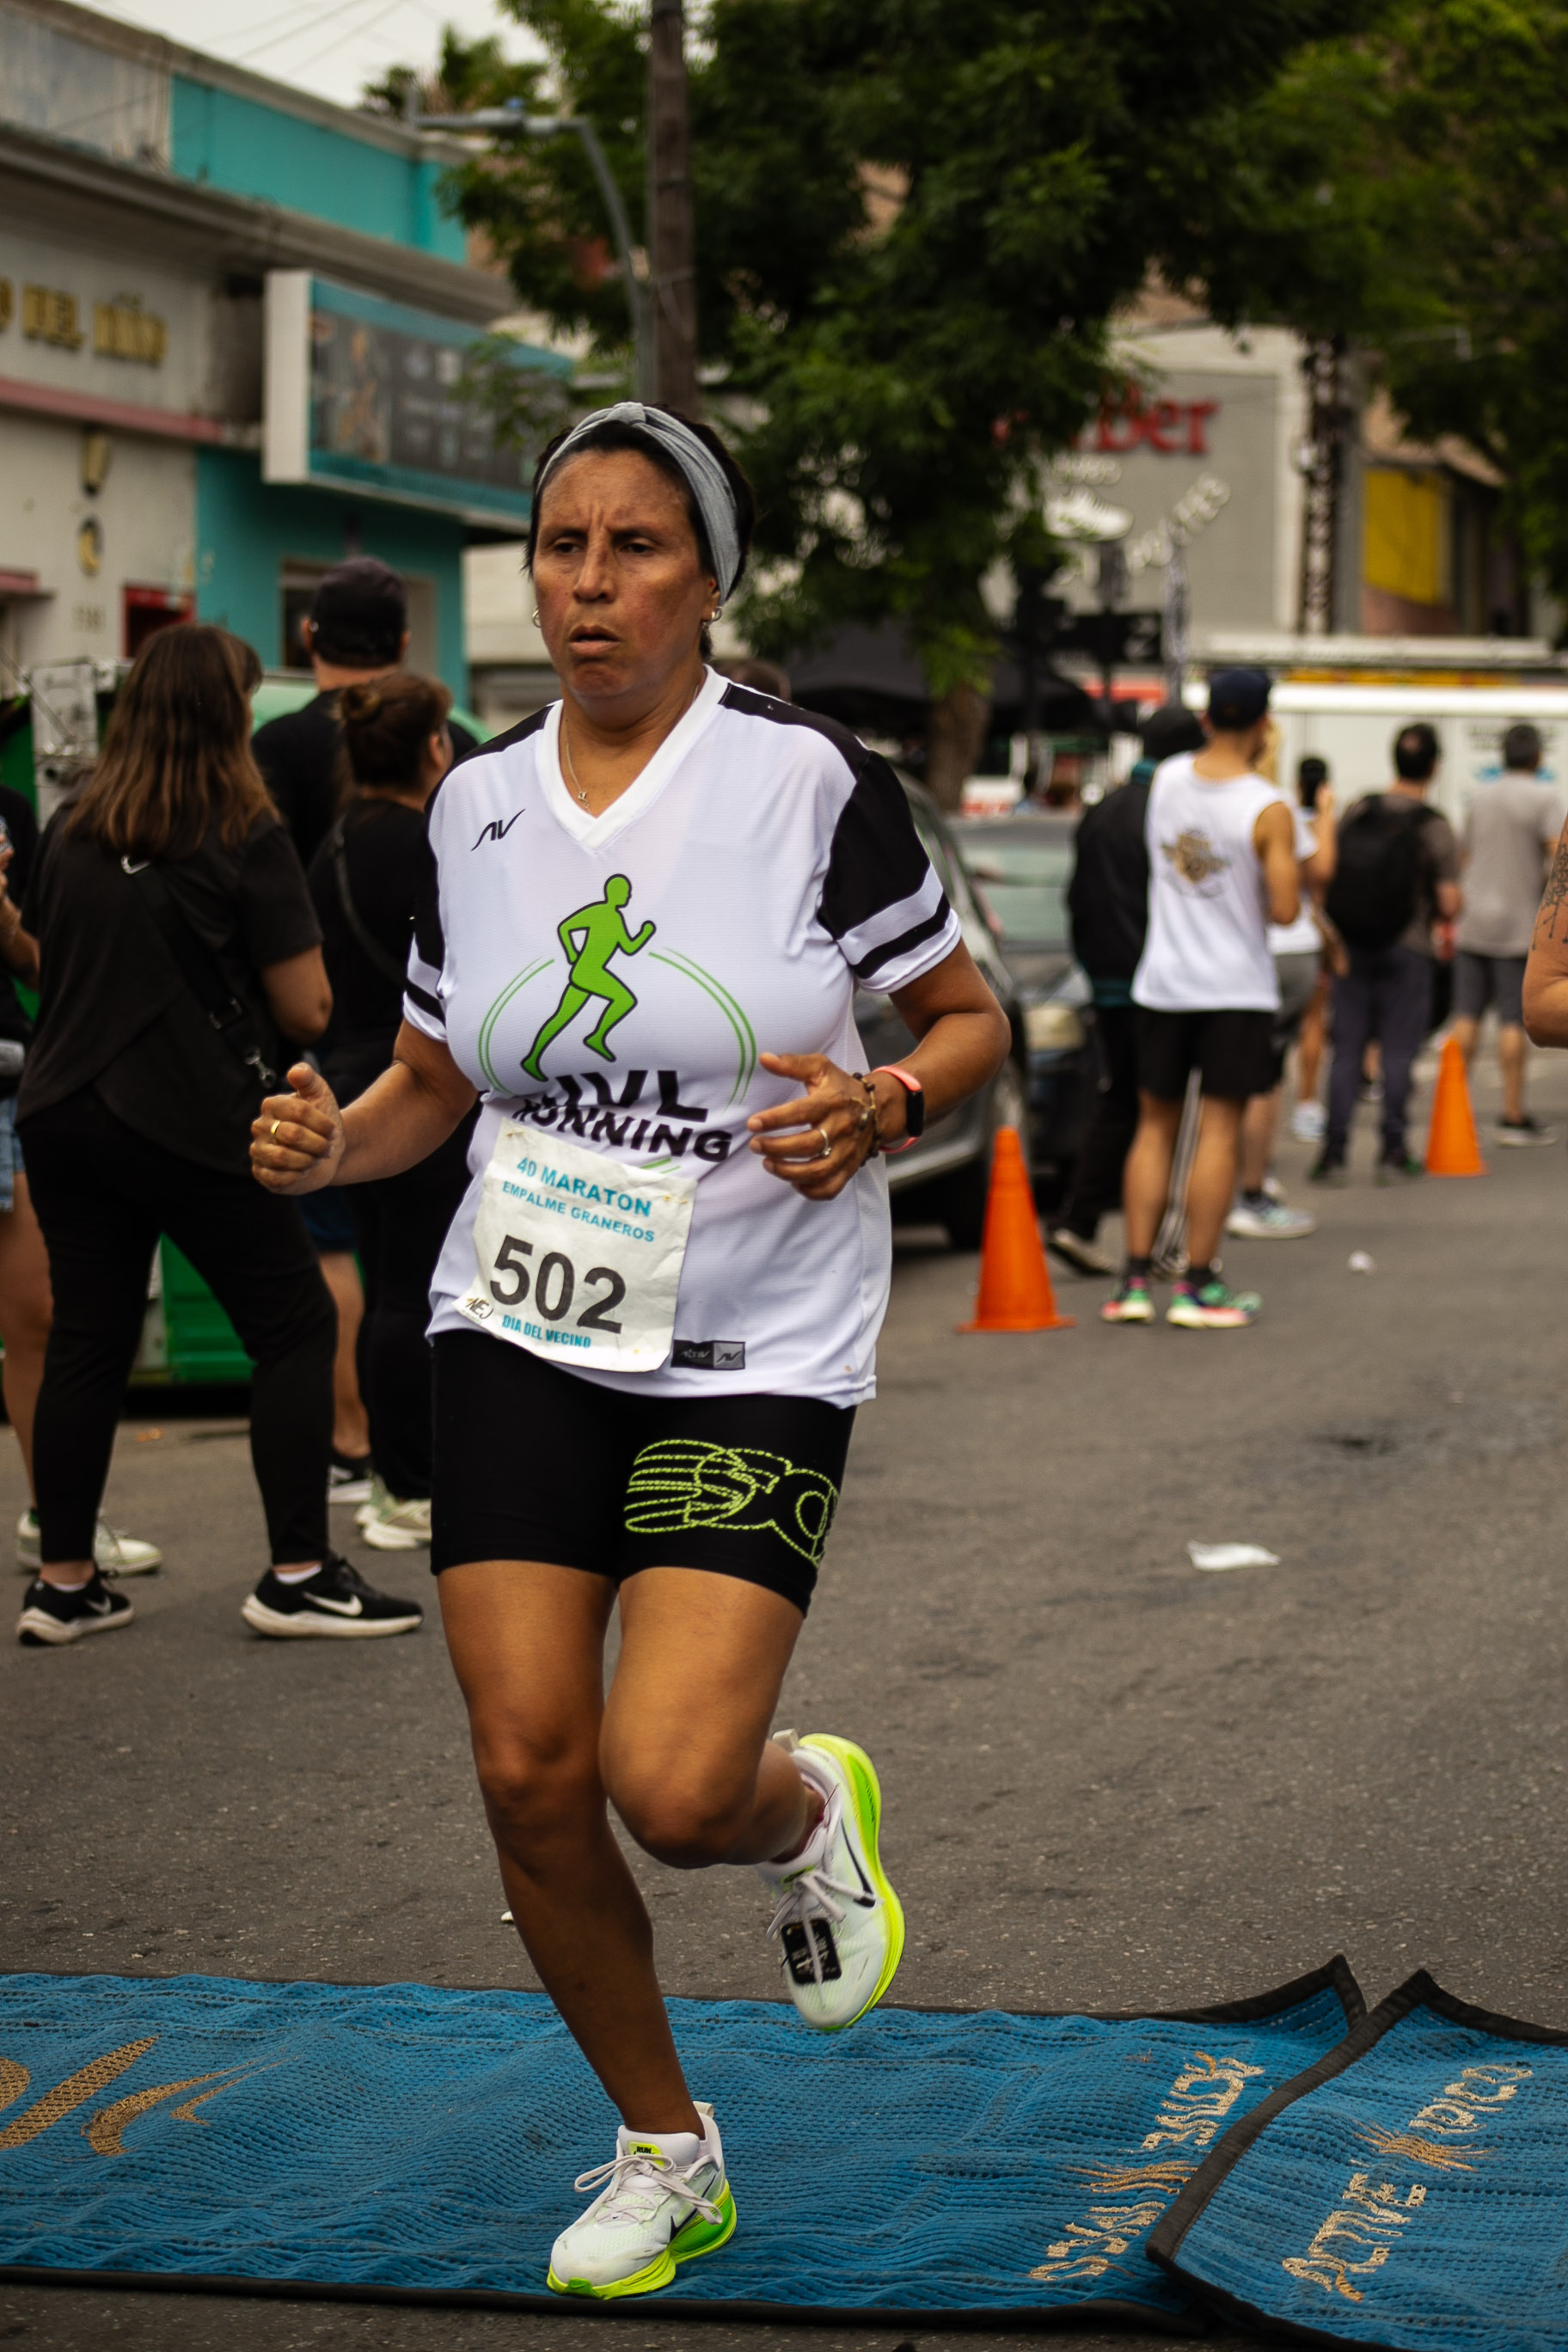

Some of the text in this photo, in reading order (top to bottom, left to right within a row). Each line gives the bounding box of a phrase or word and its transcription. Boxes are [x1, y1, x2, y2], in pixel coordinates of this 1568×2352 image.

[502, 1180, 655, 1243] EMPALME GRANEROS
[541, 1167, 652, 1217] MARATON
[489, 1234, 627, 1334] 502
[502, 1314, 522, 1332] DIA
[524, 1324, 543, 1342] DEL
[546, 1330, 591, 1348] VECINO
